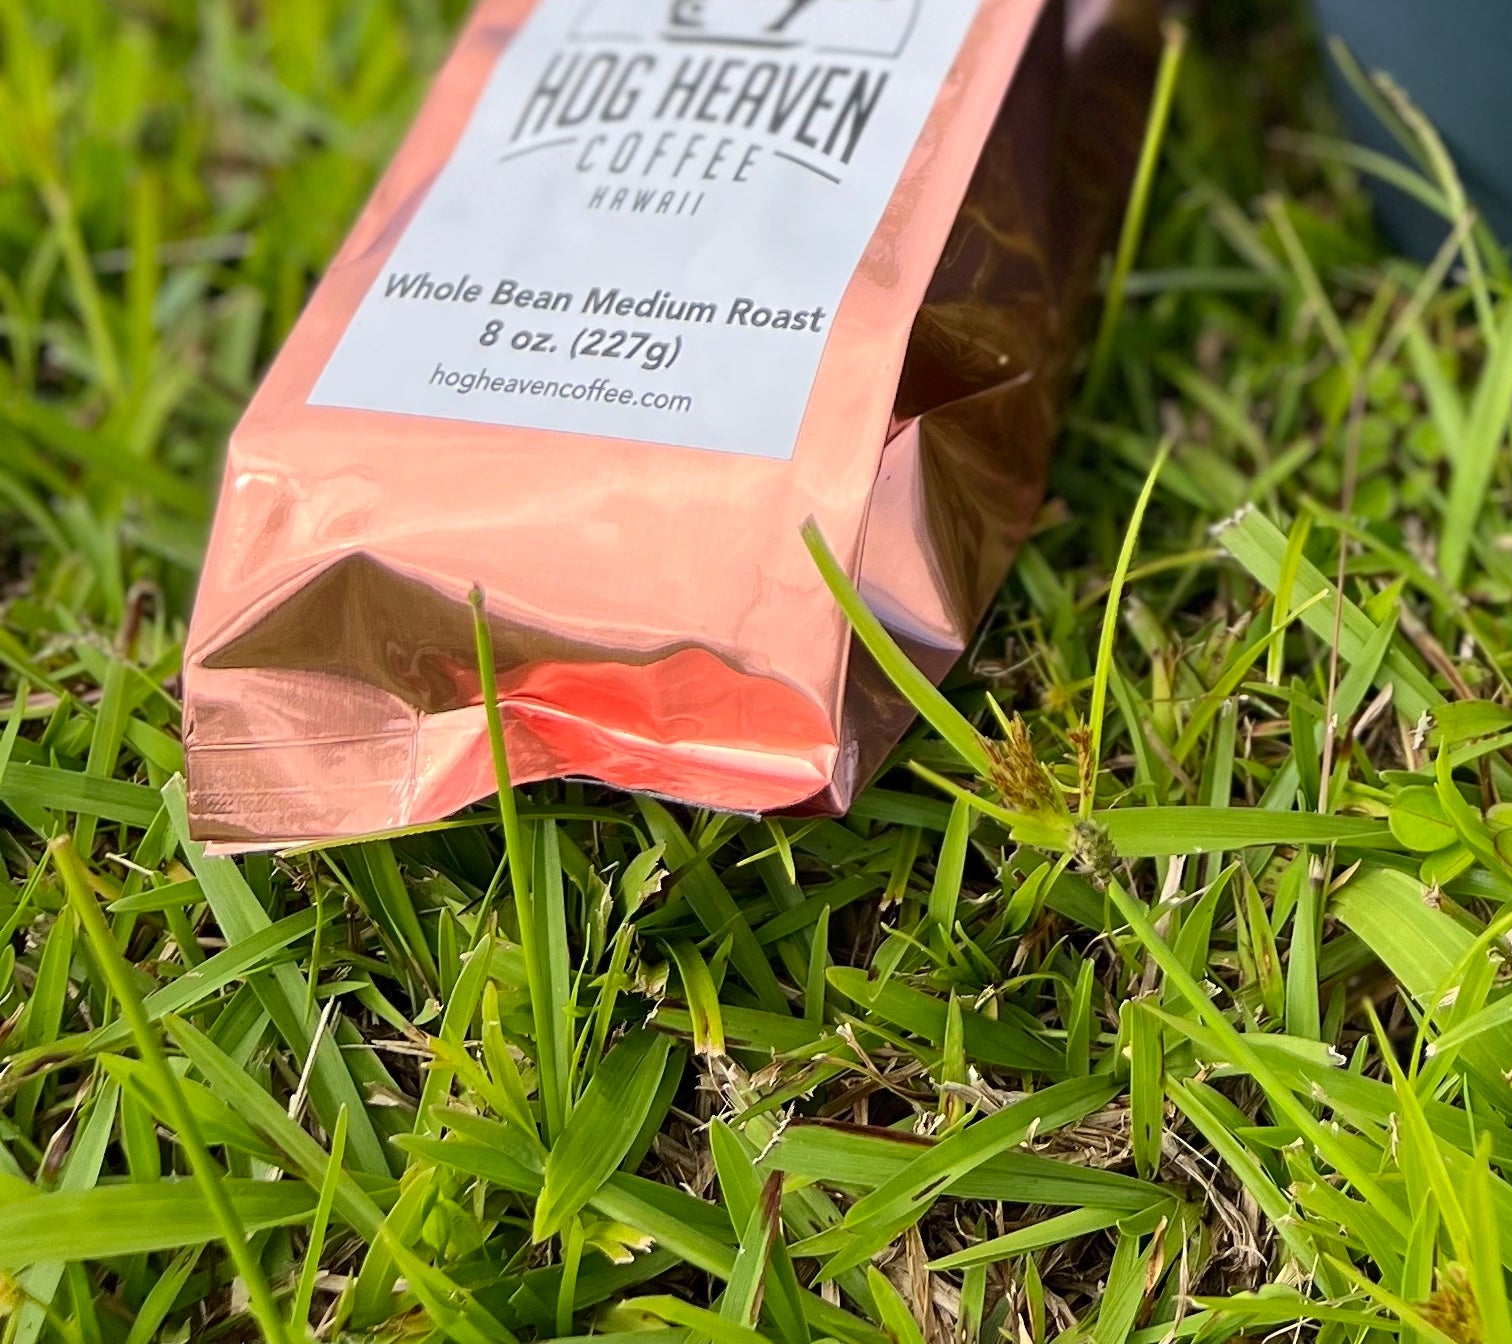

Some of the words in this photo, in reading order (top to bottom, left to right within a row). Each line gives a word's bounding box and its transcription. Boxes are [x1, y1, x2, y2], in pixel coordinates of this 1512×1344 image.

[510, 50, 655, 144] HOG
[655, 55, 889, 166] HEAVEN
[575, 130, 763, 183] COFFEE
[587, 186, 705, 217] HAWAII
[384, 272, 483, 304] Whole
[489, 279, 573, 313] Bean
[581, 286, 718, 324] Medium
[725, 297, 826, 333] Roast
[478, 320, 500, 347] 8
[511, 330, 557, 357] oz.
[569, 327, 682, 370] (227g)
[429, 363, 692, 413] hogheavencoffee.com
